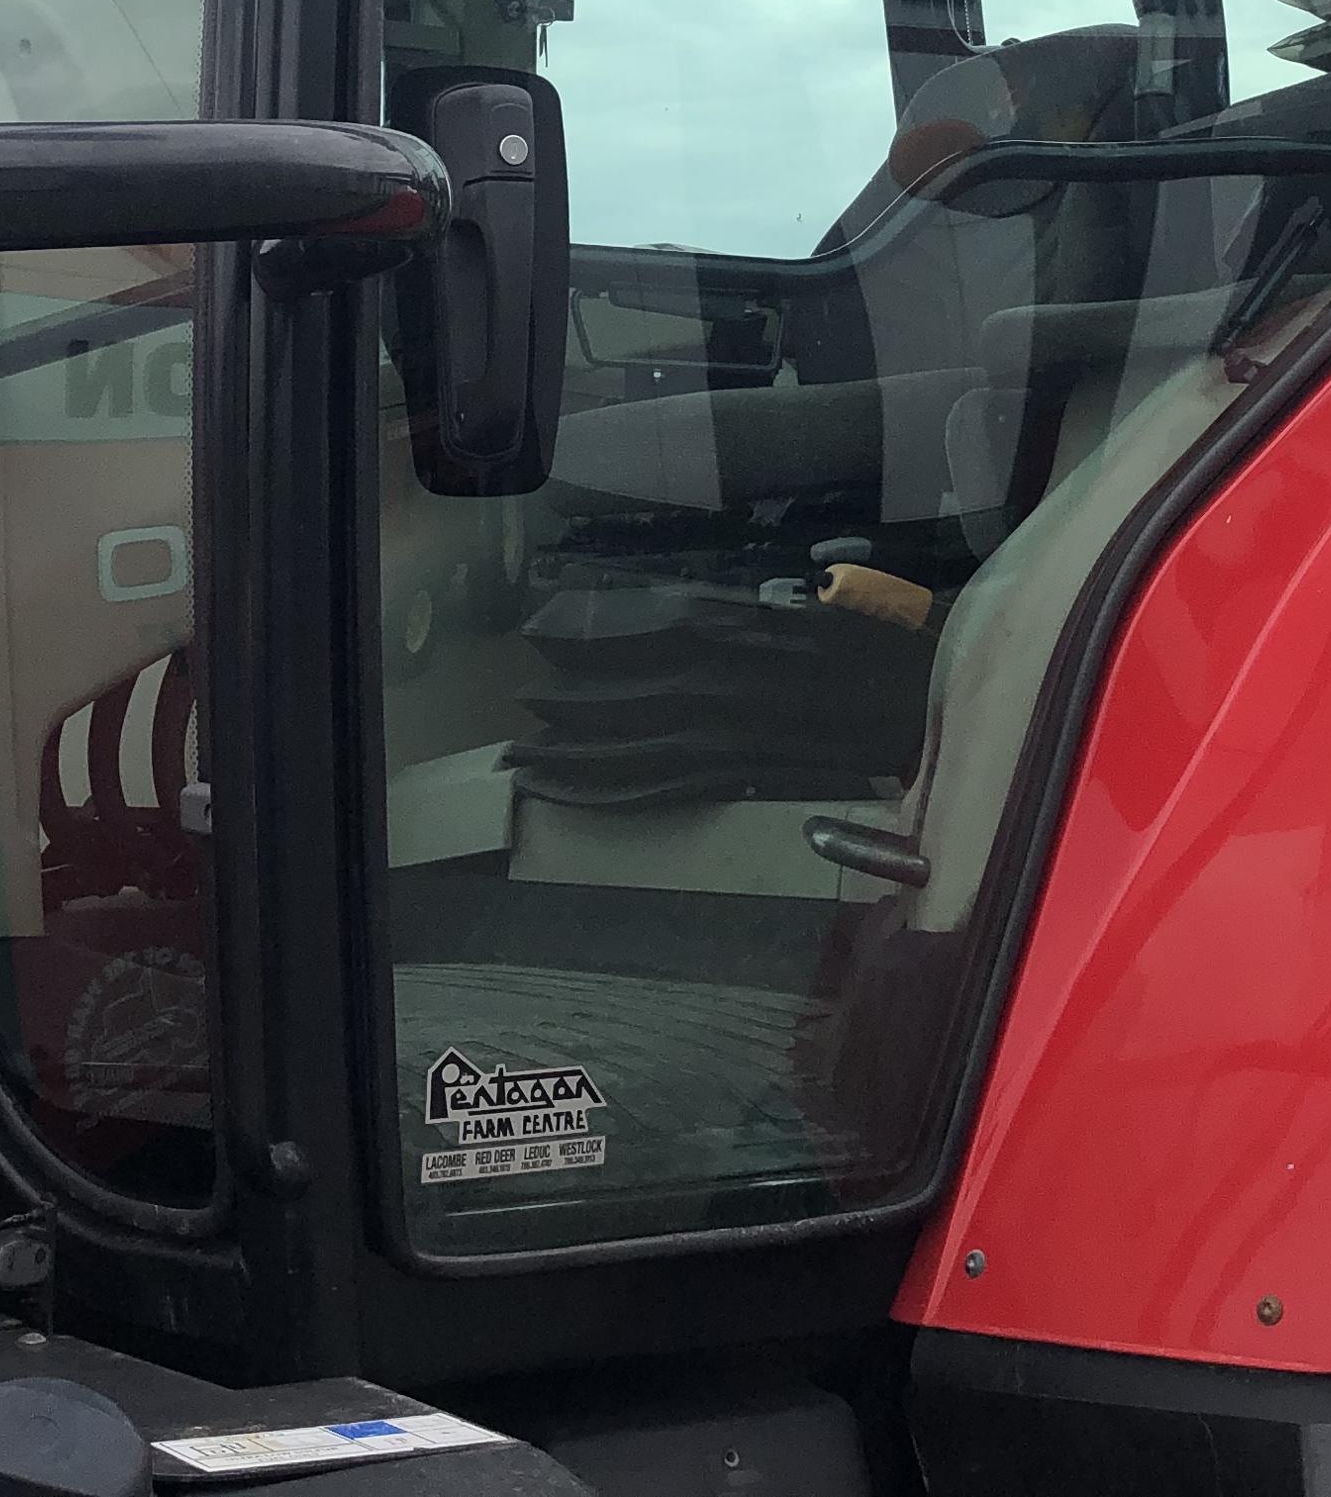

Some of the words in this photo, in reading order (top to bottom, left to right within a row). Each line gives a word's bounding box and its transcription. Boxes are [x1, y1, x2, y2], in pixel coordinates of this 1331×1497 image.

[430, 1051, 603, 1120] Pentagon
[462, 1118, 514, 1141] FARM
[425, 1153, 467, 1171] LACOMBE
[475, 1152, 493, 1165] RED
[494, 1149, 516, 1163] DEER
[523, 1145, 551, 1161] LEDUC
[559, 1139, 602, 1156] WESTLOCK
